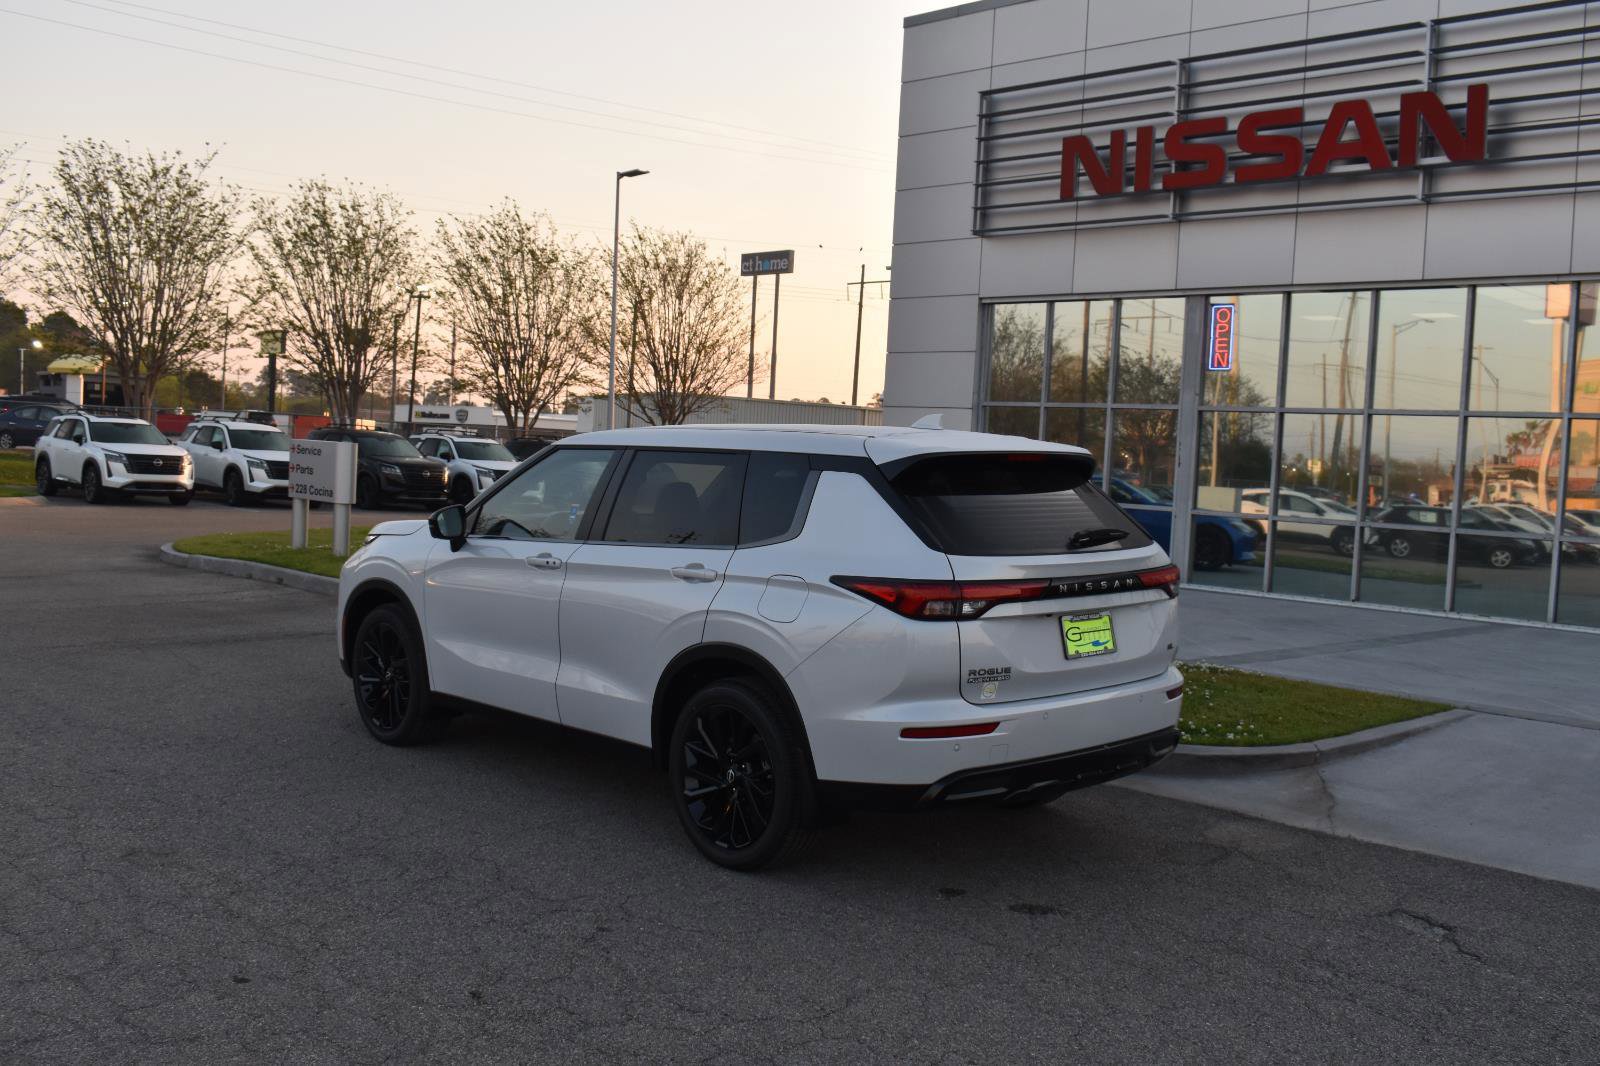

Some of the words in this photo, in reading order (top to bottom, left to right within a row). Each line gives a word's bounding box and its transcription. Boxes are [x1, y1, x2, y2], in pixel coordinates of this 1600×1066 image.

[1060, 83, 1489, 200] NISSAN
[755, 255, 789, 272] home
[1213, 308, 1231, 368] OPEN
[295, 444, 322, 456] Service
[295, 463, 314, 475] Parts
[308, 485, 334, 498] Cocina
[1059, 578, 1134, 593] NISSAN
[968, 666, 1012, 677] ROGUE
